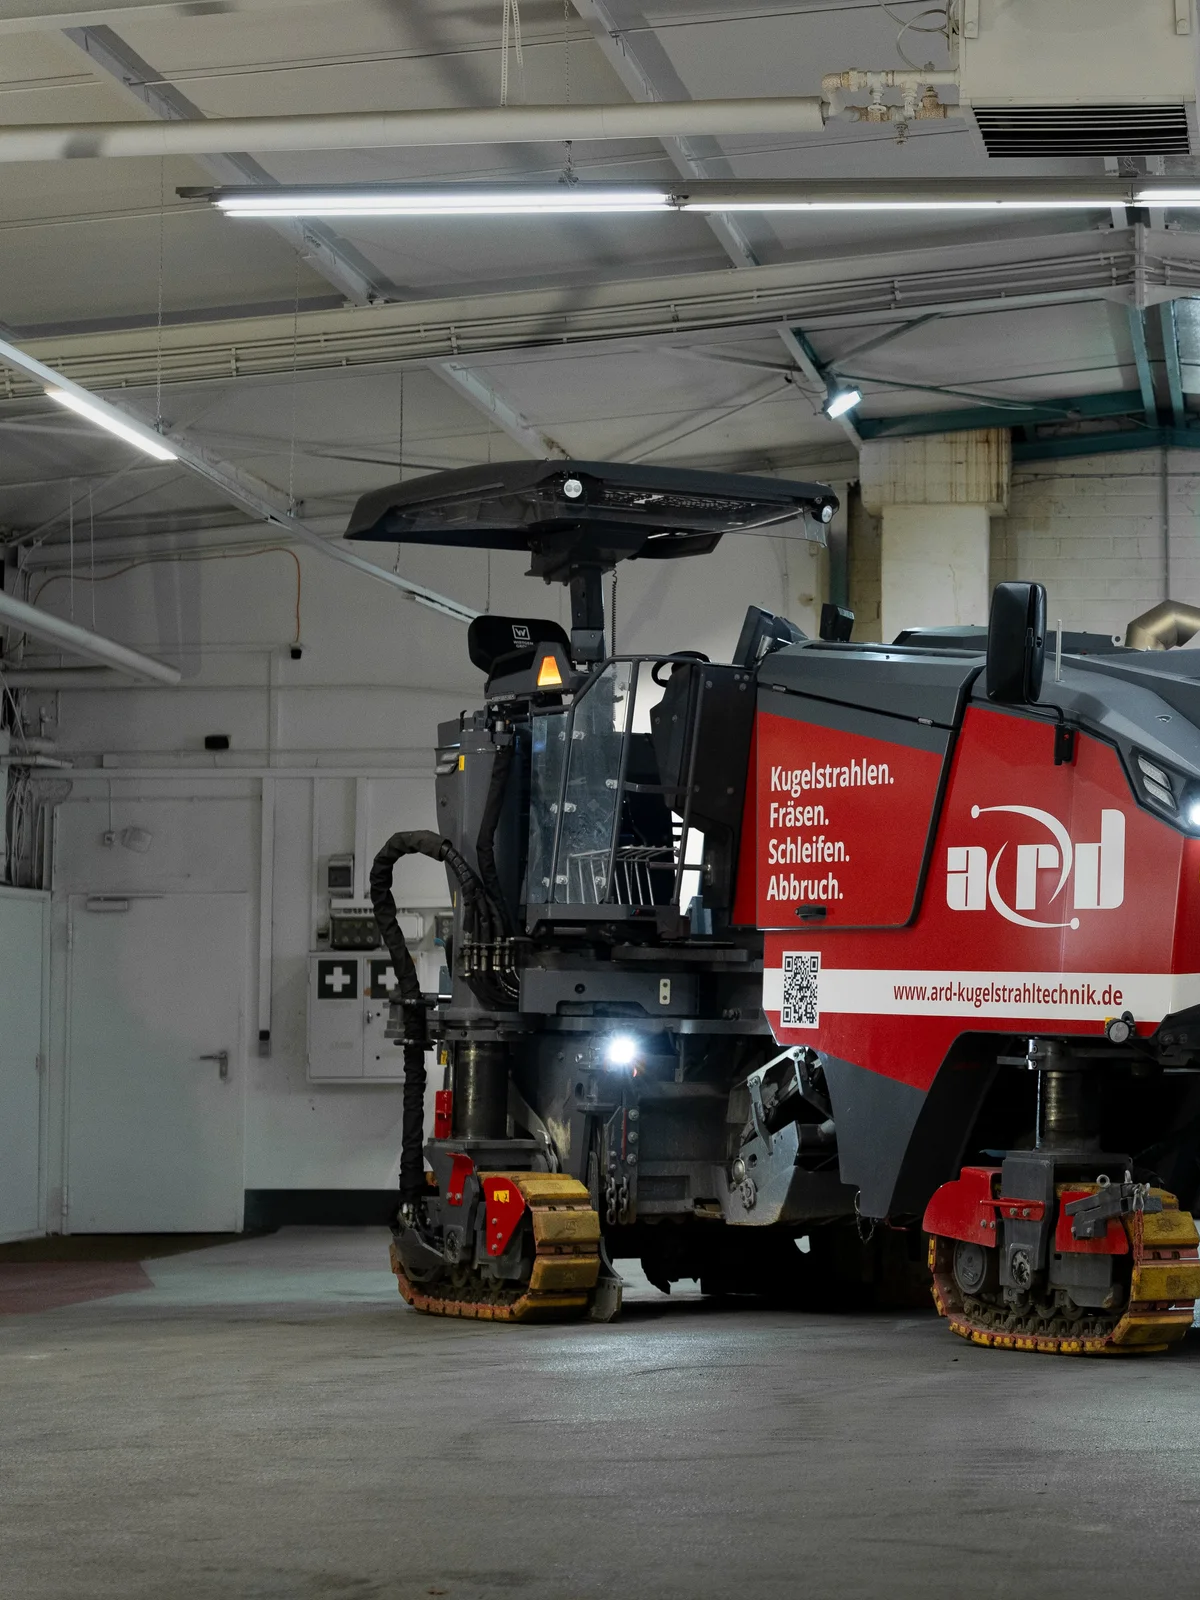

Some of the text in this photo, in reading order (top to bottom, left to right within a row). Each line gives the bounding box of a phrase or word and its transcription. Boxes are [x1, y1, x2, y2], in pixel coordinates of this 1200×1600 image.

[770, 758, 895, 799] Kugelstrahlen.
[769, 800, 830, 829] Fräsen.
[767, 835, 850, 865] Schleifen.
[946, 808, 1126, 911] ard
[766, 871, 844, 901] Abbruch.
[893, 981, 1124, 1009] www.ard-kugelstrahltechnik.de
